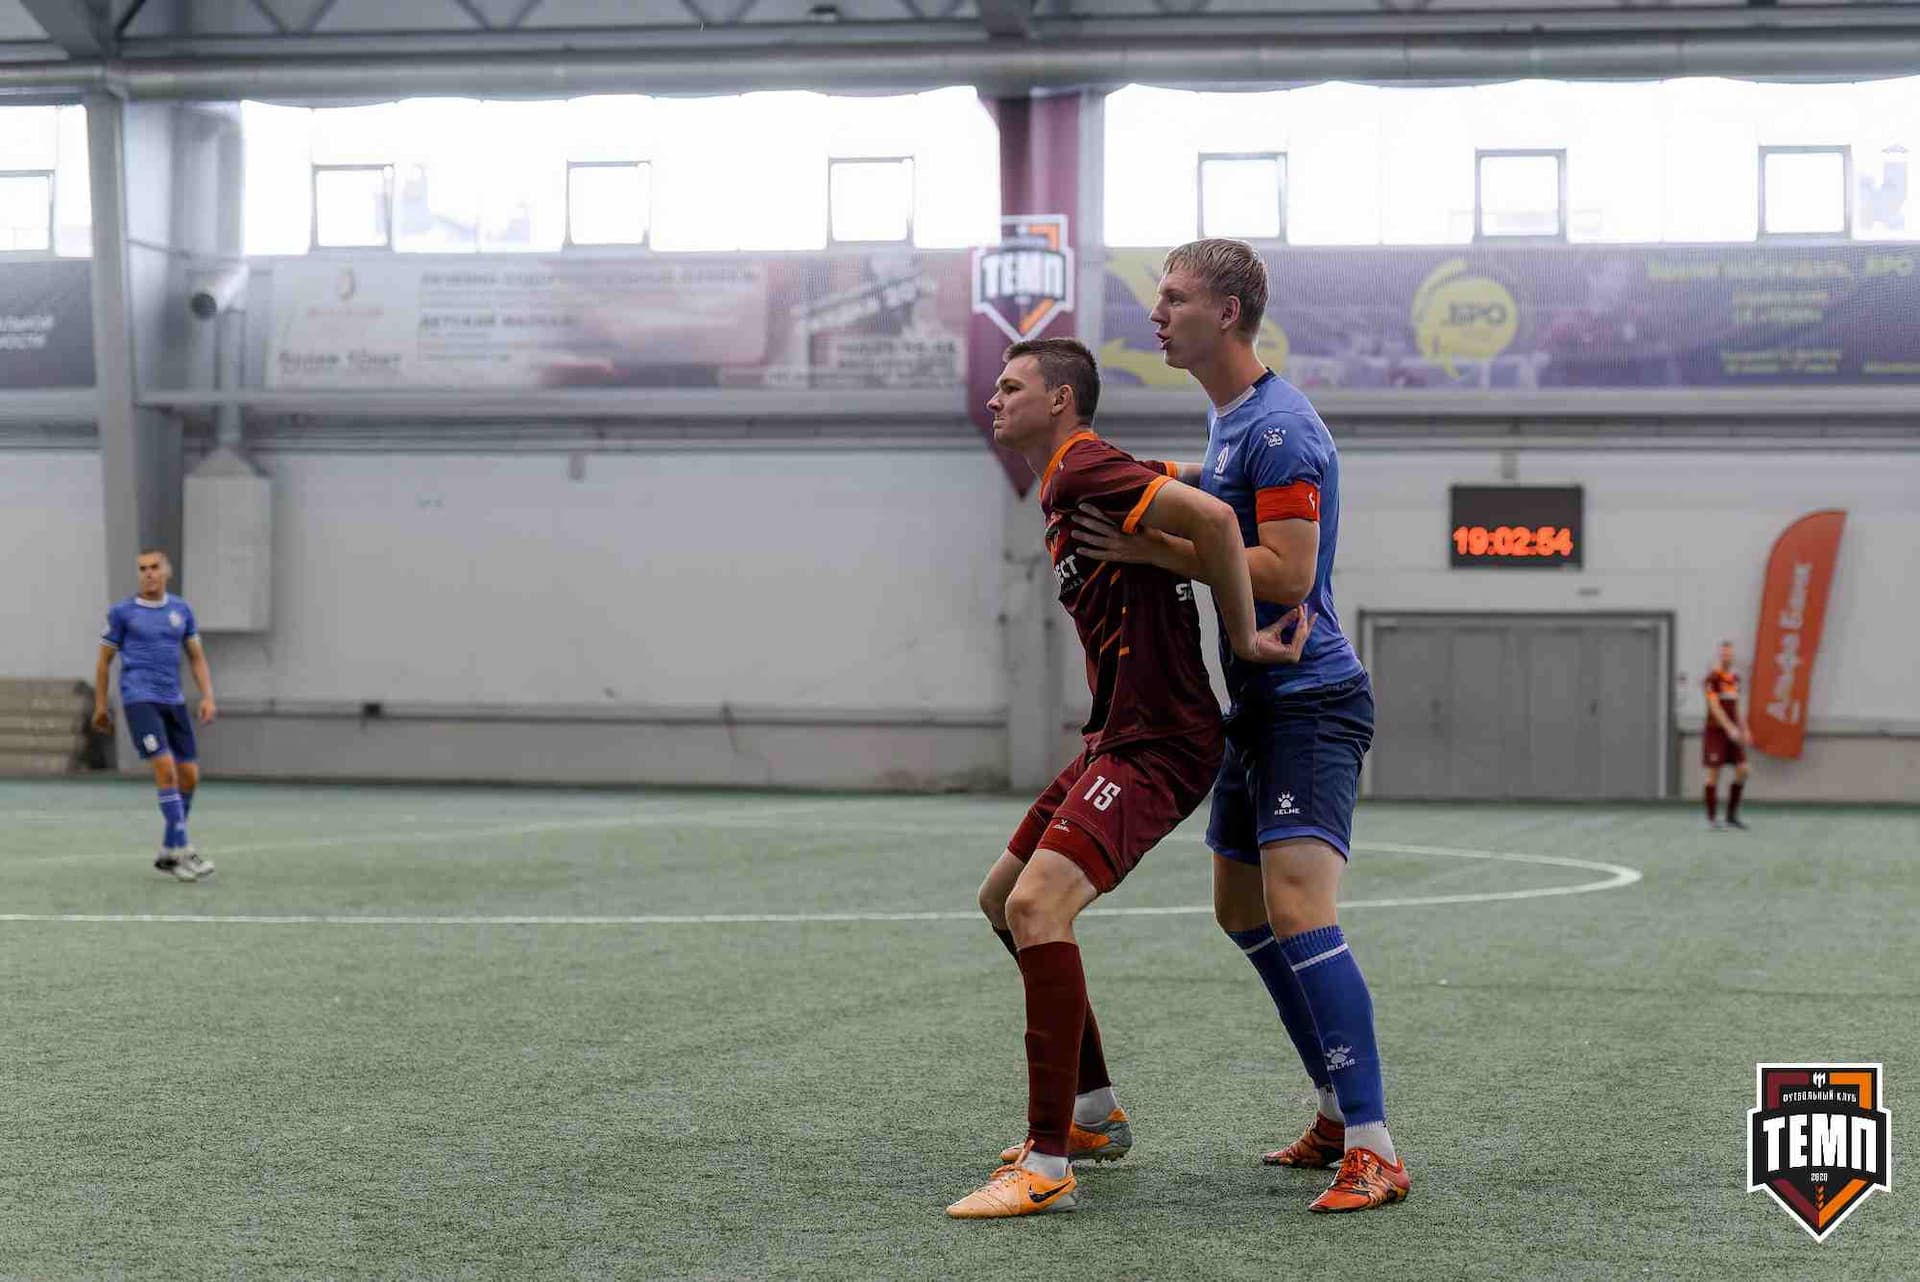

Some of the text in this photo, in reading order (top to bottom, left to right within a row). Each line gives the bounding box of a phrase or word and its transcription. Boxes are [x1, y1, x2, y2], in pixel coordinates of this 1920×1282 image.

[982, 251, 1063, 298] ТЕМП
[1453, 526, 1573, 557] 19:02:54
[1779, 562, 1813, 629] Банк
[1083, 775, 1121, 811] 15
